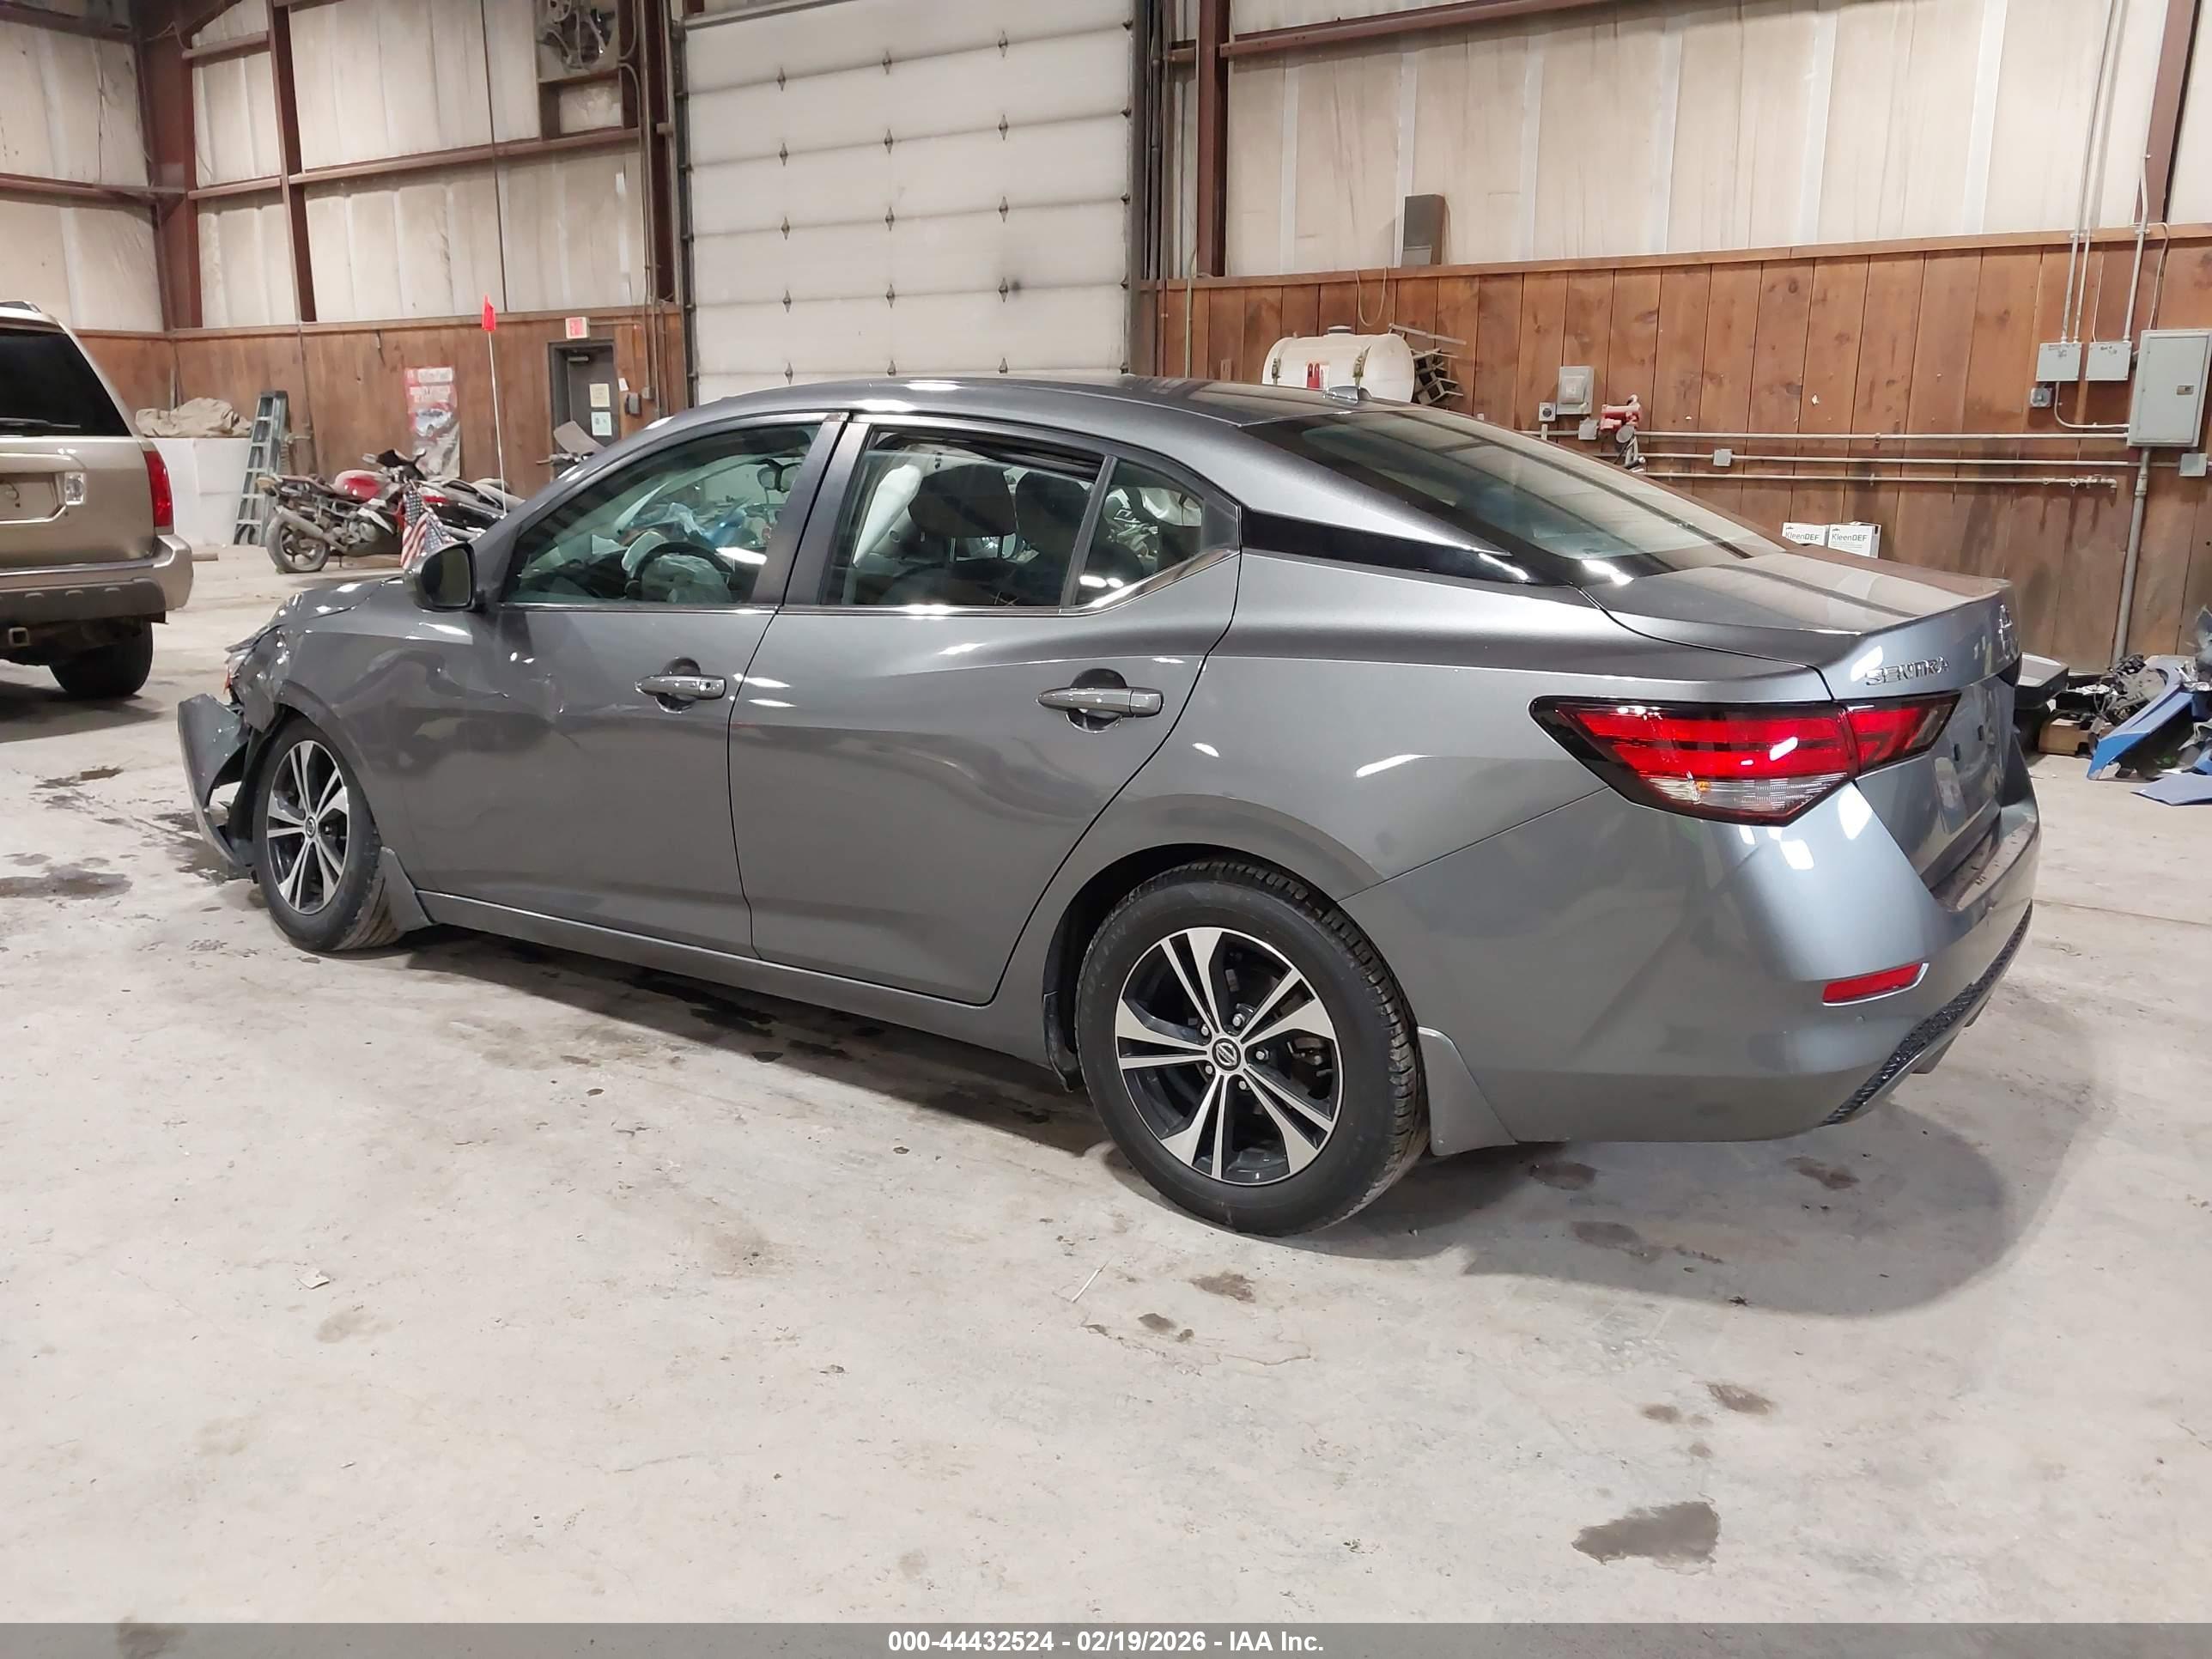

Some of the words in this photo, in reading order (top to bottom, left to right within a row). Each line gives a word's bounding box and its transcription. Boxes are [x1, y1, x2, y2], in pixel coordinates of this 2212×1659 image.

[1785, 531, 1820, 541] KleenDEF
[1832, 532, 1868, 542] KleenDEF
[1865, 655, 1949, 686] SENTRA
